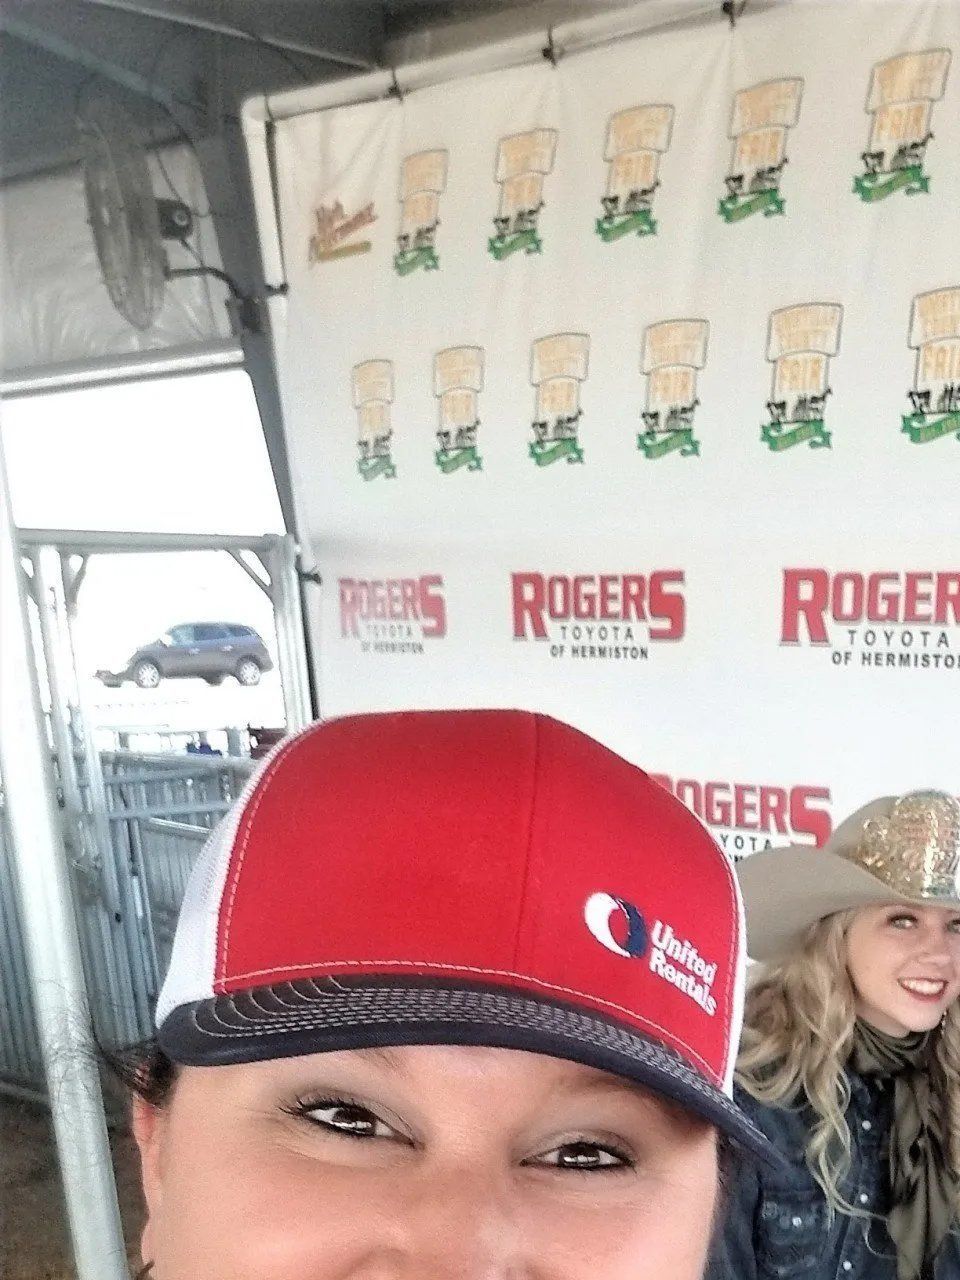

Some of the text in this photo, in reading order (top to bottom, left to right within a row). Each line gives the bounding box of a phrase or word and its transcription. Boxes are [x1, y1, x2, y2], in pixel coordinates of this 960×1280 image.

[337, 574, 447, 639] ROGERS
[511, 569, 687, 641] ROGERS
[550, 645, 650, 660] OF HERMISTON
[561, 626, 635, 642] TOYOTA
[847, 629, 950, 648] TOYOTA
[831, 651, 852, 666] OF
[650, 773, 832, 848] OGERS
[719, 833, 773, 851] YOTA
[650, 919, 718, 986] United
[649, 947, 717, 1017] Rentals
